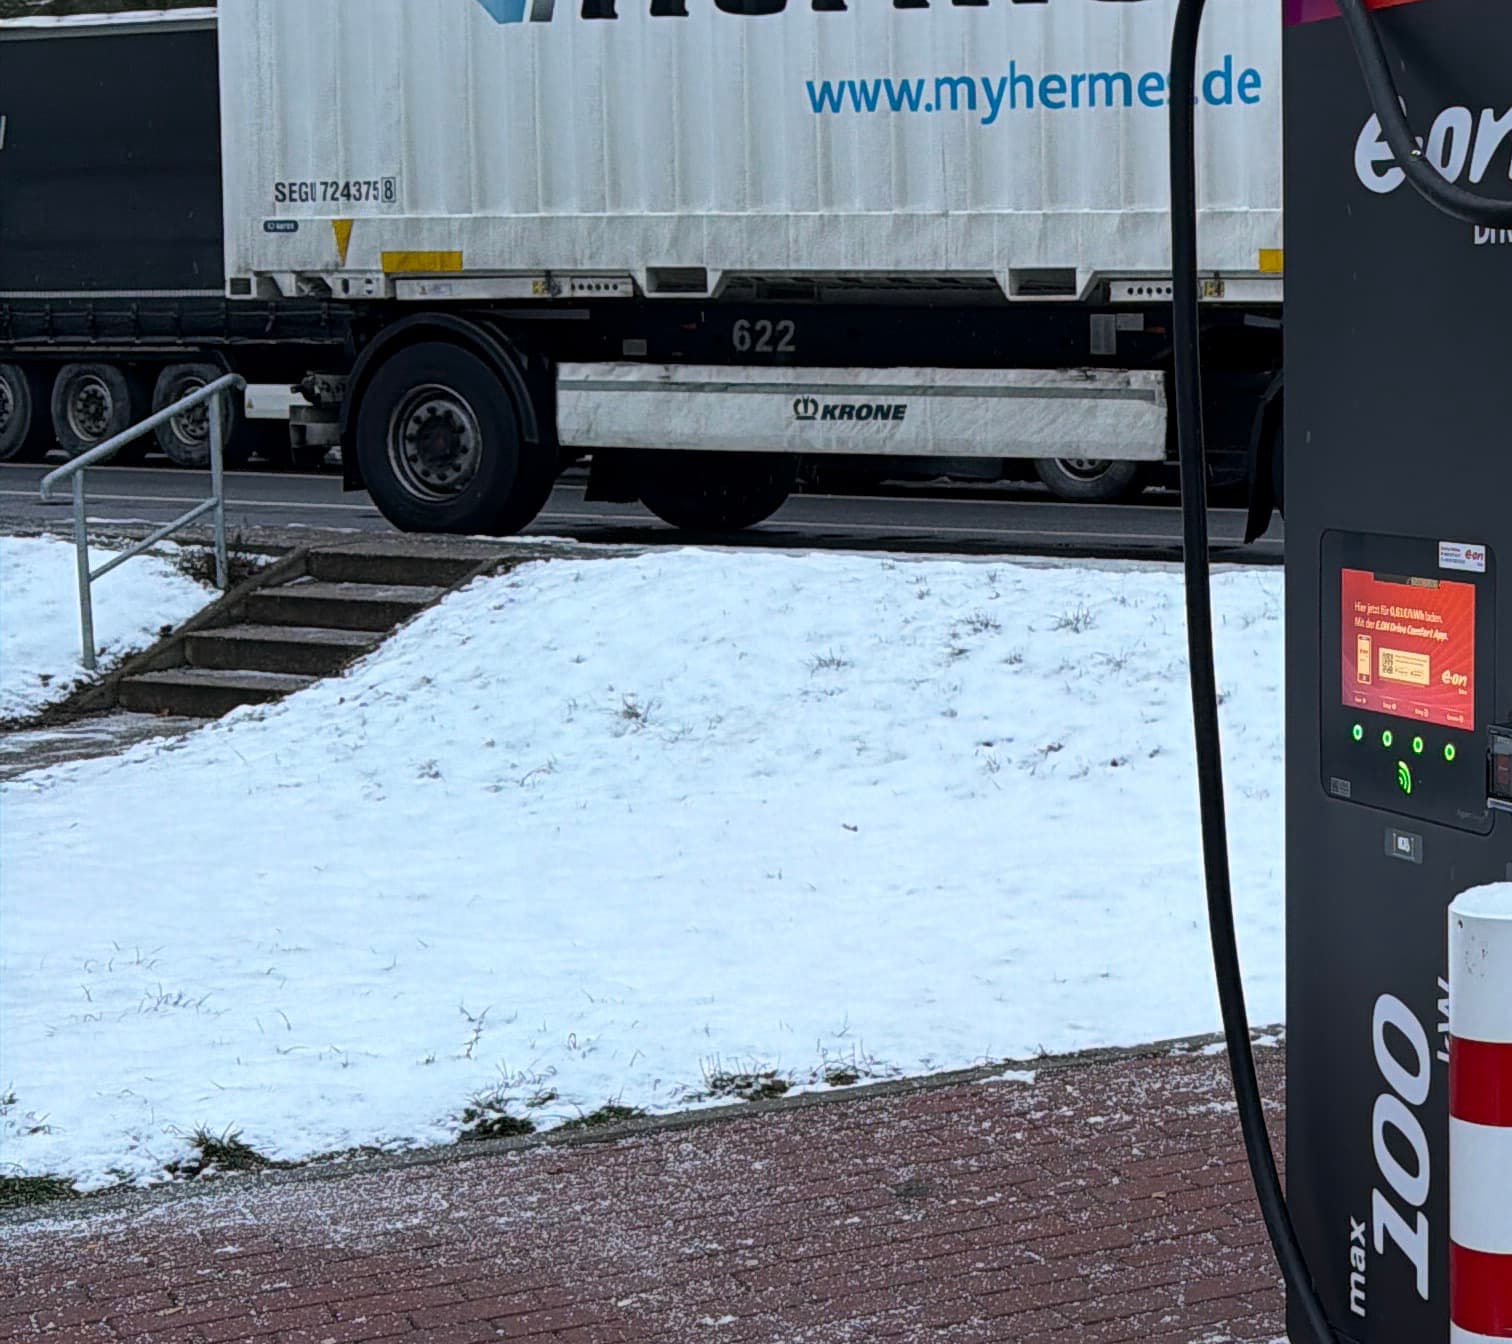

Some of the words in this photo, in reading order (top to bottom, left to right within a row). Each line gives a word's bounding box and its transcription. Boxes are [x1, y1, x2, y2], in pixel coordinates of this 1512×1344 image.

[806, 54, 1262, 125] www.myherme.de
[274, 181, 317, 203] SEGU
[319, 180, 380, 202] 724375
[732, 319, 796, 352] 622
[820, 404, 908, 421] KRONE
[1350, 1216, 1366, 1317] max
[1372, 992, 1431, 1302] 100
